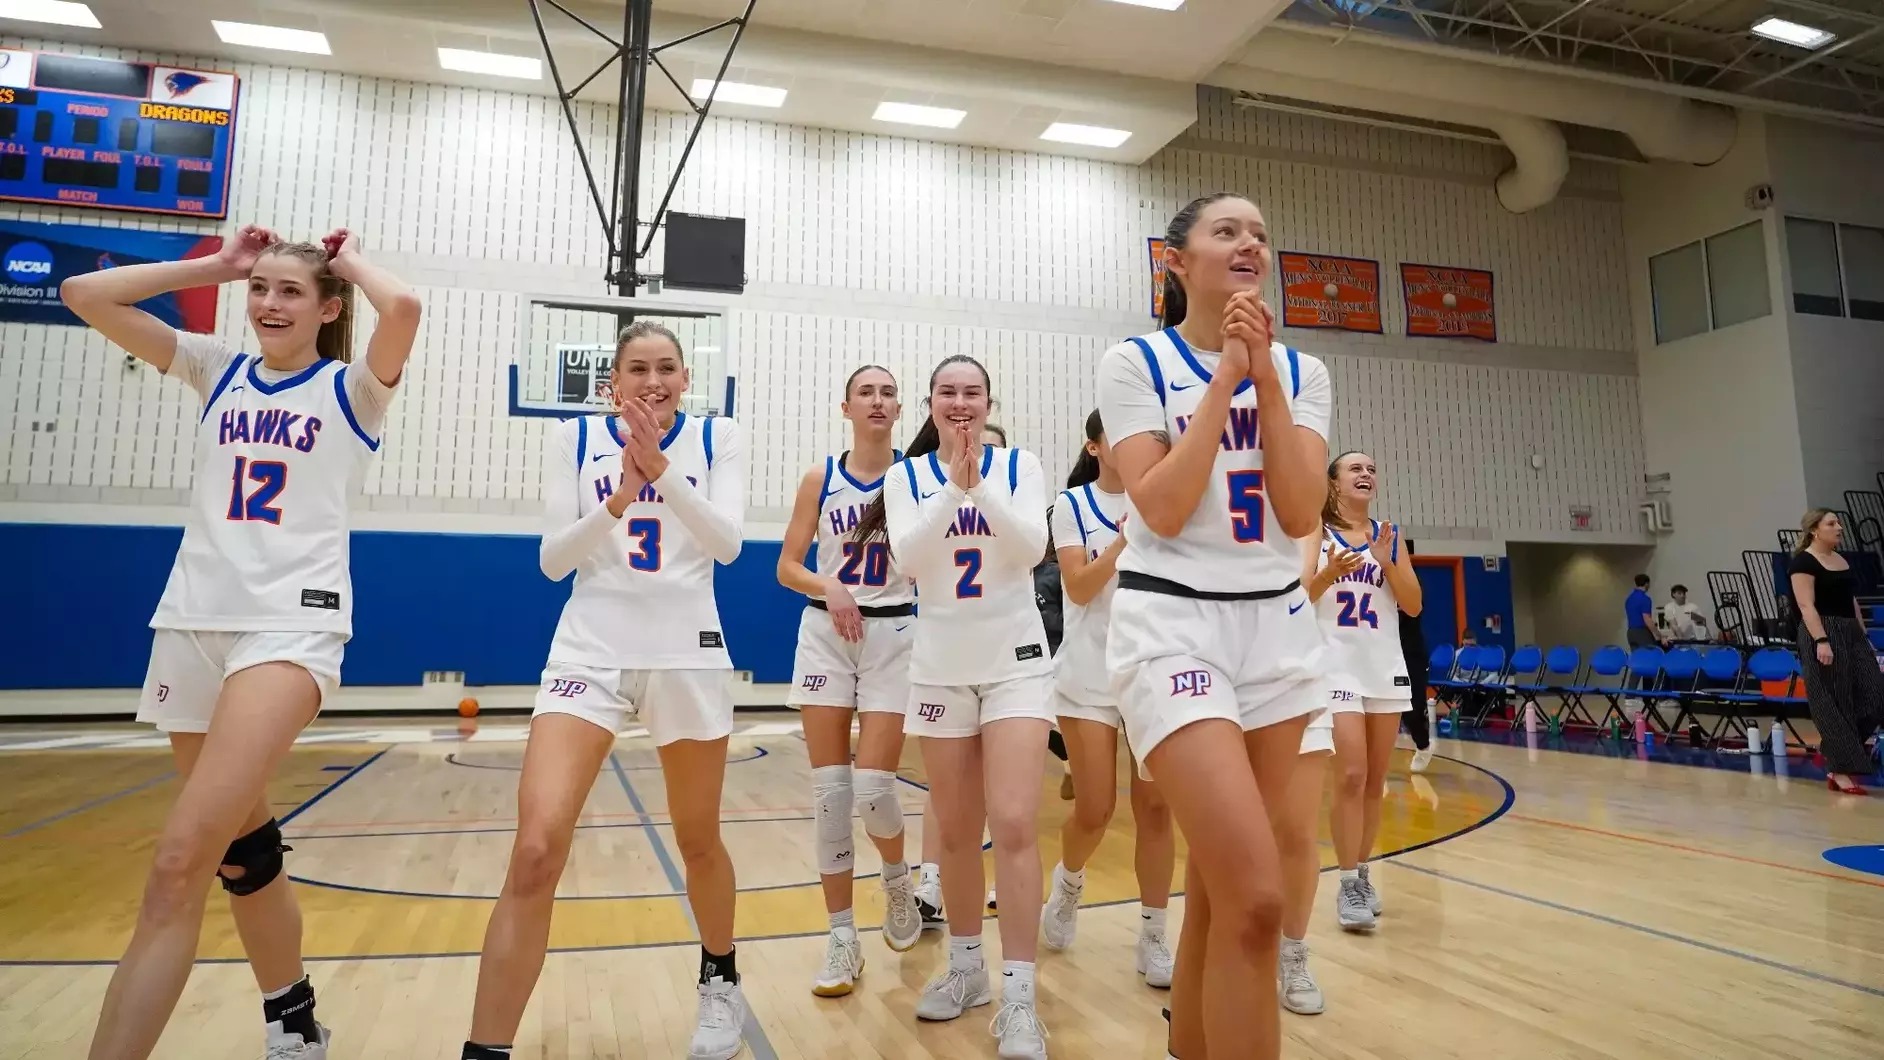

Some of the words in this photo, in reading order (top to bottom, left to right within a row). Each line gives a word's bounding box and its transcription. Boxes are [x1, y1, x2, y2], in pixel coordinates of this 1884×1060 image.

[67, 103, 109, 118] PERIOD
[140, 103, 229, 126] DRAGONS
[42, 146, 85, 161] PLAYER
[94, 151, 122, 164] FOUL
[58, 190, 98, 202] MATCH
[7, 260, 51, 274] NCAA
[1306, 257, 1351, 275] NCAA
[1316, 310, 1348, 326] 2017
[219, 408, 322, 453] HAWKS
[226, 455, 288, 526] 12
[1226, 469, 1265, 543] 5
[627, 517, 662, 573] 3
[837, 541, 889, 586] 20
[953, 547, 983, 600] 2
[1336, 590, 1379, 630] 24
[550, 678, 587, 698] NP
[802, 675, 827, 691] NP
[1169, 670, 1212, 697] NP
[918, 703, 945, 722] NP
